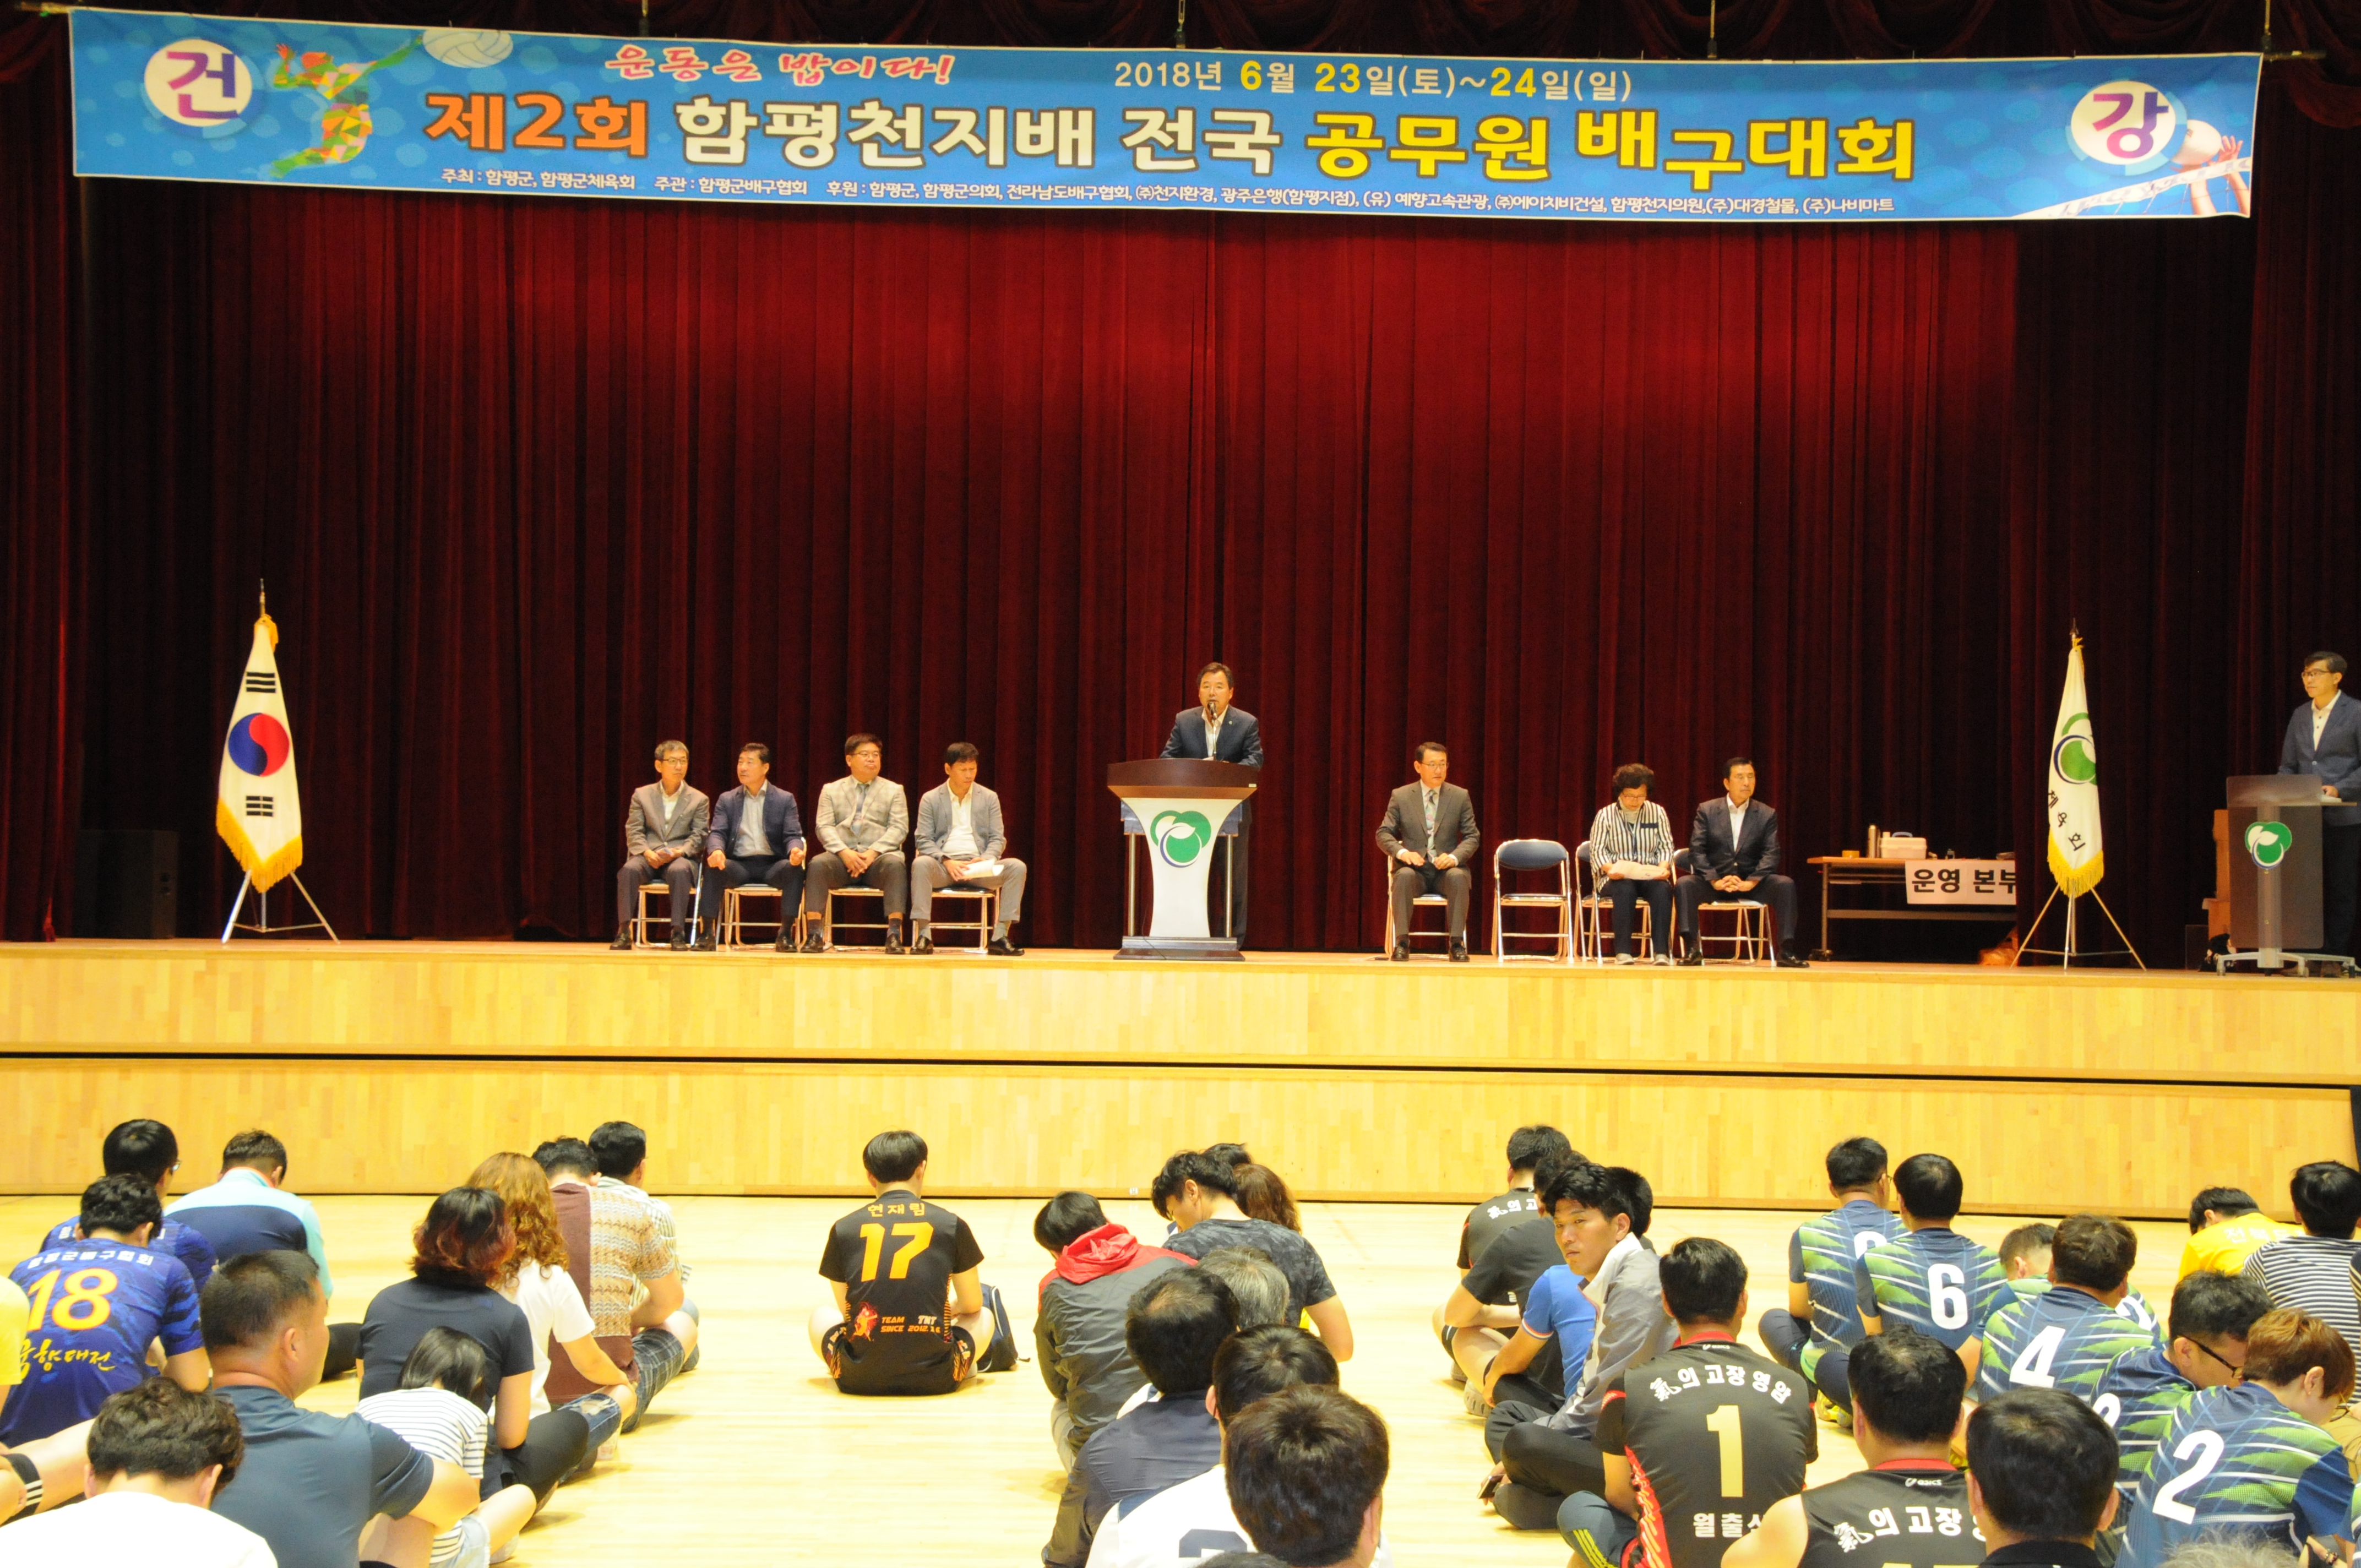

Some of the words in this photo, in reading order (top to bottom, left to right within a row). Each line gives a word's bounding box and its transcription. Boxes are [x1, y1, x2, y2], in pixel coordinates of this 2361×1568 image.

[166, 50, 238, 119] 건
[605, 44, 761, 81] 운동은
[779, 52, 955, 85] 밥이다!
[1115, 61, 1221, 91] 2018년
[1241, 61, 1294, 93] 6월
[423, 91, 649, 159] 제2회
[675, 94, 1095, 170] 함평천지배
[1119, 107, 1282, 176] 전국
[1305, 110, 1551, 182] 공무원
[1575, 108, 1915, 192] 배구대회
[2092, 91, 2169, 159] 강
[486, 168, 537, 188] 함평군,
[540, 171, 635, 190] 함평군체육회
[698, 177, 807, 195] 함평군배구협회
[869, 181, 920, 199] 함평군,
[922, 183, 1003, 200] 함평군의회,
[1007, 184, 1133, 201] 전라남도배구협회,
[1912, 869, 1960, 893] 운영
[859, 1222, 934, 1282] 17
[28, 1267, 118, 1332] 18
[918, 1315, 937, 1325] TNT
[1927, 1264, 1968, 1330] 6
[1704, 1364, 1745, 1386] 고장
[1753, 1371, 1792, 1404] 영암
[2010, 1325, 2065, 1387] 4
[1706, 1405, 1743, 1498] 1
[2152, 1430, 2224, 1524] 2
[1906, 1506, 1962, 1536] 고장
